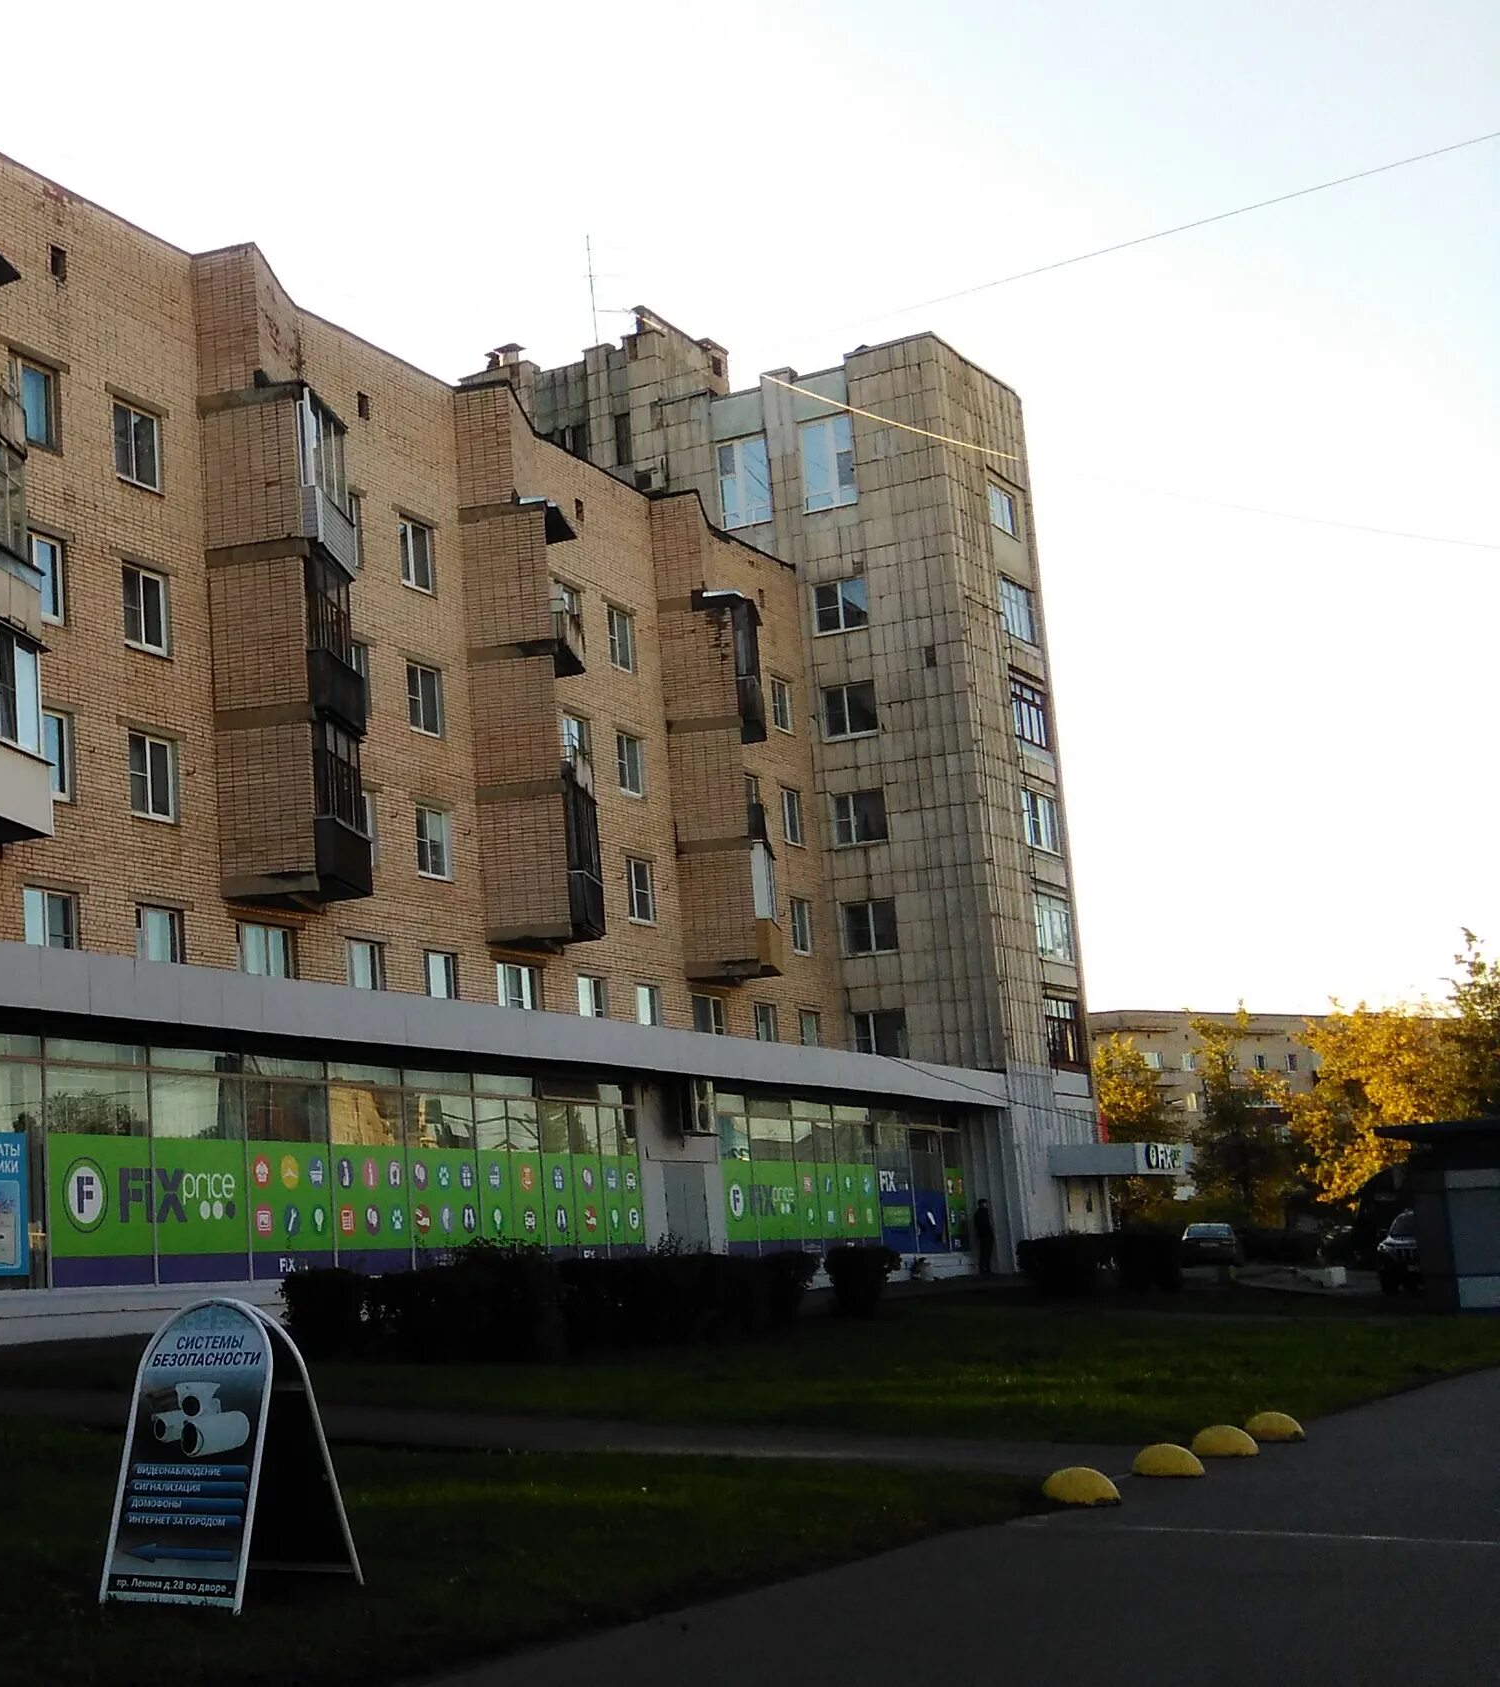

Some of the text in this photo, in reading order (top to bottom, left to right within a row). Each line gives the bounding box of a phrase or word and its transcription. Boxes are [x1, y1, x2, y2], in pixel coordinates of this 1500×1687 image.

[182, 1173, 236, 1206] price
[176, 1335, 244, 1350] СИСТЕМЫ
[152, 1352, 261, 1367] БЕЗОПАСНОСТИ
[137, 1466, 221, 1477] ВИДЕОНАБЛЮДЕНИЕ
[134, 1483, 201, 1493] СИГНАЛИЗАЦИЯ
[131, 1499, 182, 1509] ДОМОФОНЫ
[128, 1515, 226, 1527] ИНТЕРНЕТ ЗА ГОРОДОМ
[116, 1579, 129, 1589] пр.
[131, 1578, 162, 1589] Ленина
[186, 1582, 197, 1590] во
[198, 1583, 227, 1594] дворе
